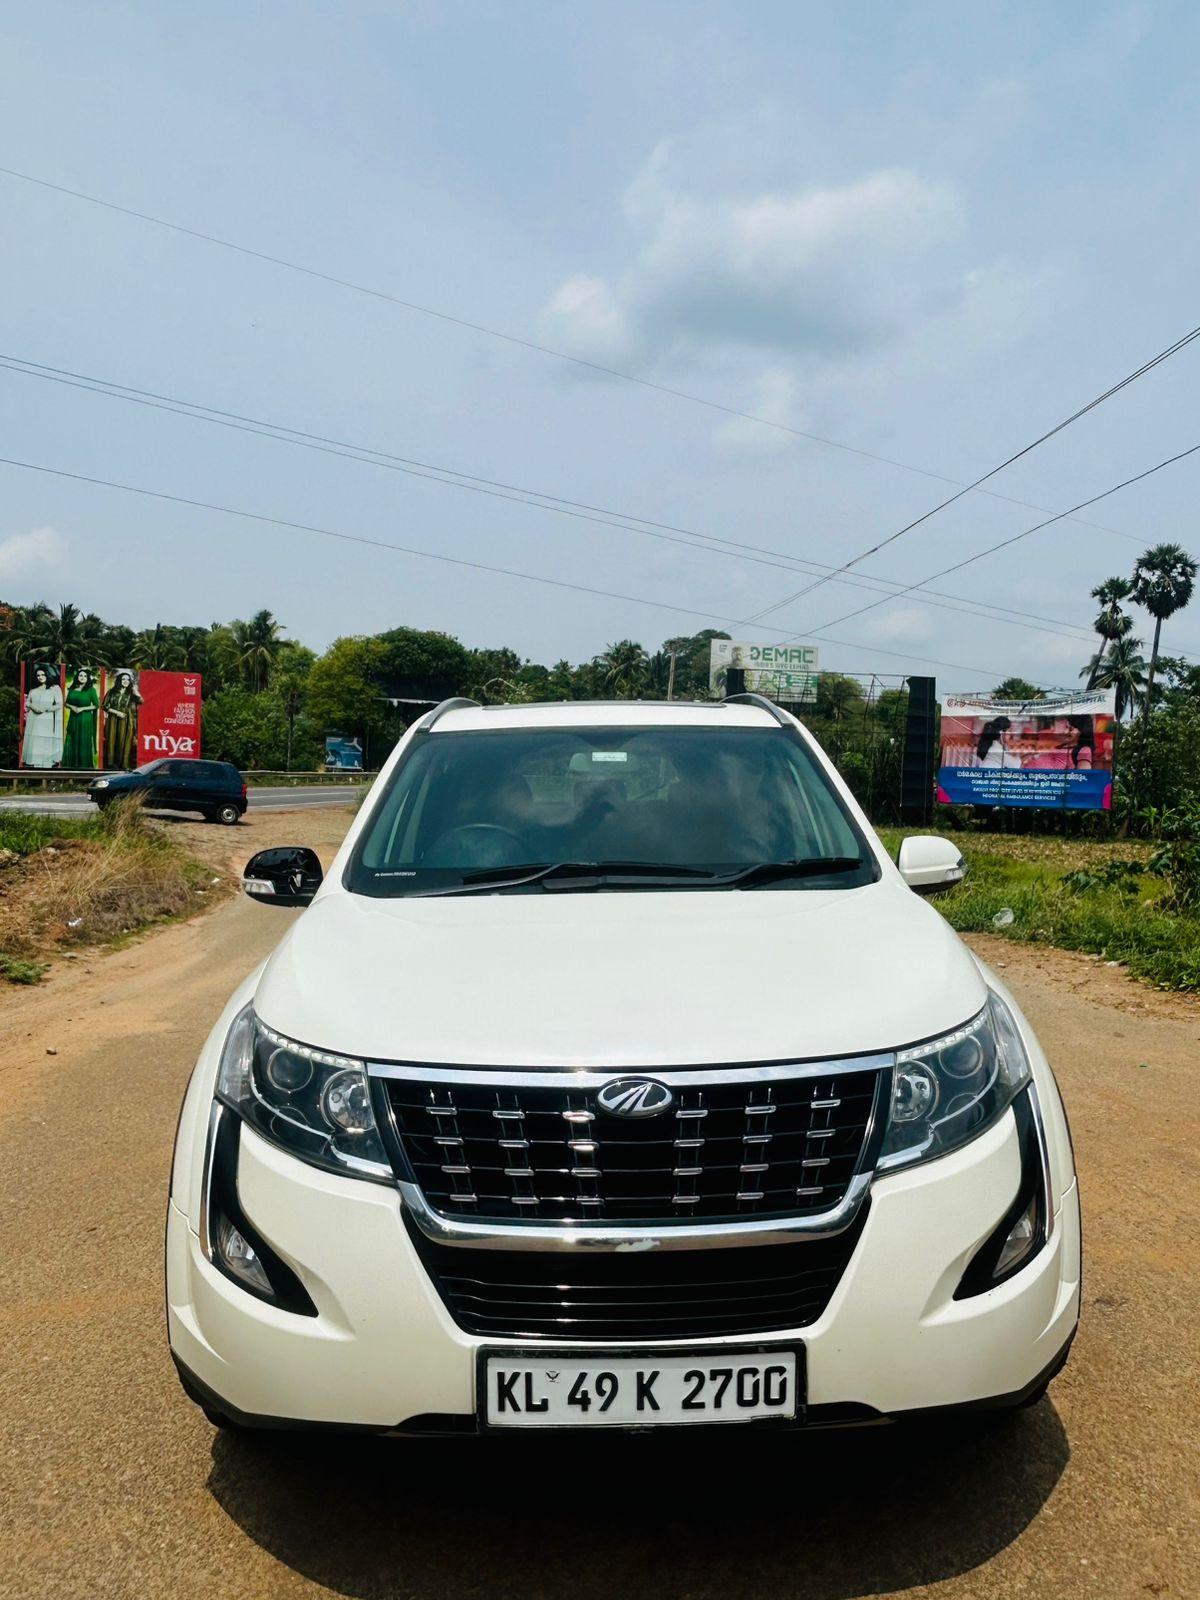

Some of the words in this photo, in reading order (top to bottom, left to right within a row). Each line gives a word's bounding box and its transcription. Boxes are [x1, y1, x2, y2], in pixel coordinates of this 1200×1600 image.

[750, 646, 814, 664] DEMAC
[143, 729, 196, 756] niya
[497, 1371, 549, 1412] KL
[567, 1372, 619, 1412] 49
[636, 1370, 660, 1411] K
[682, 1365, 787, 1410] 2700
